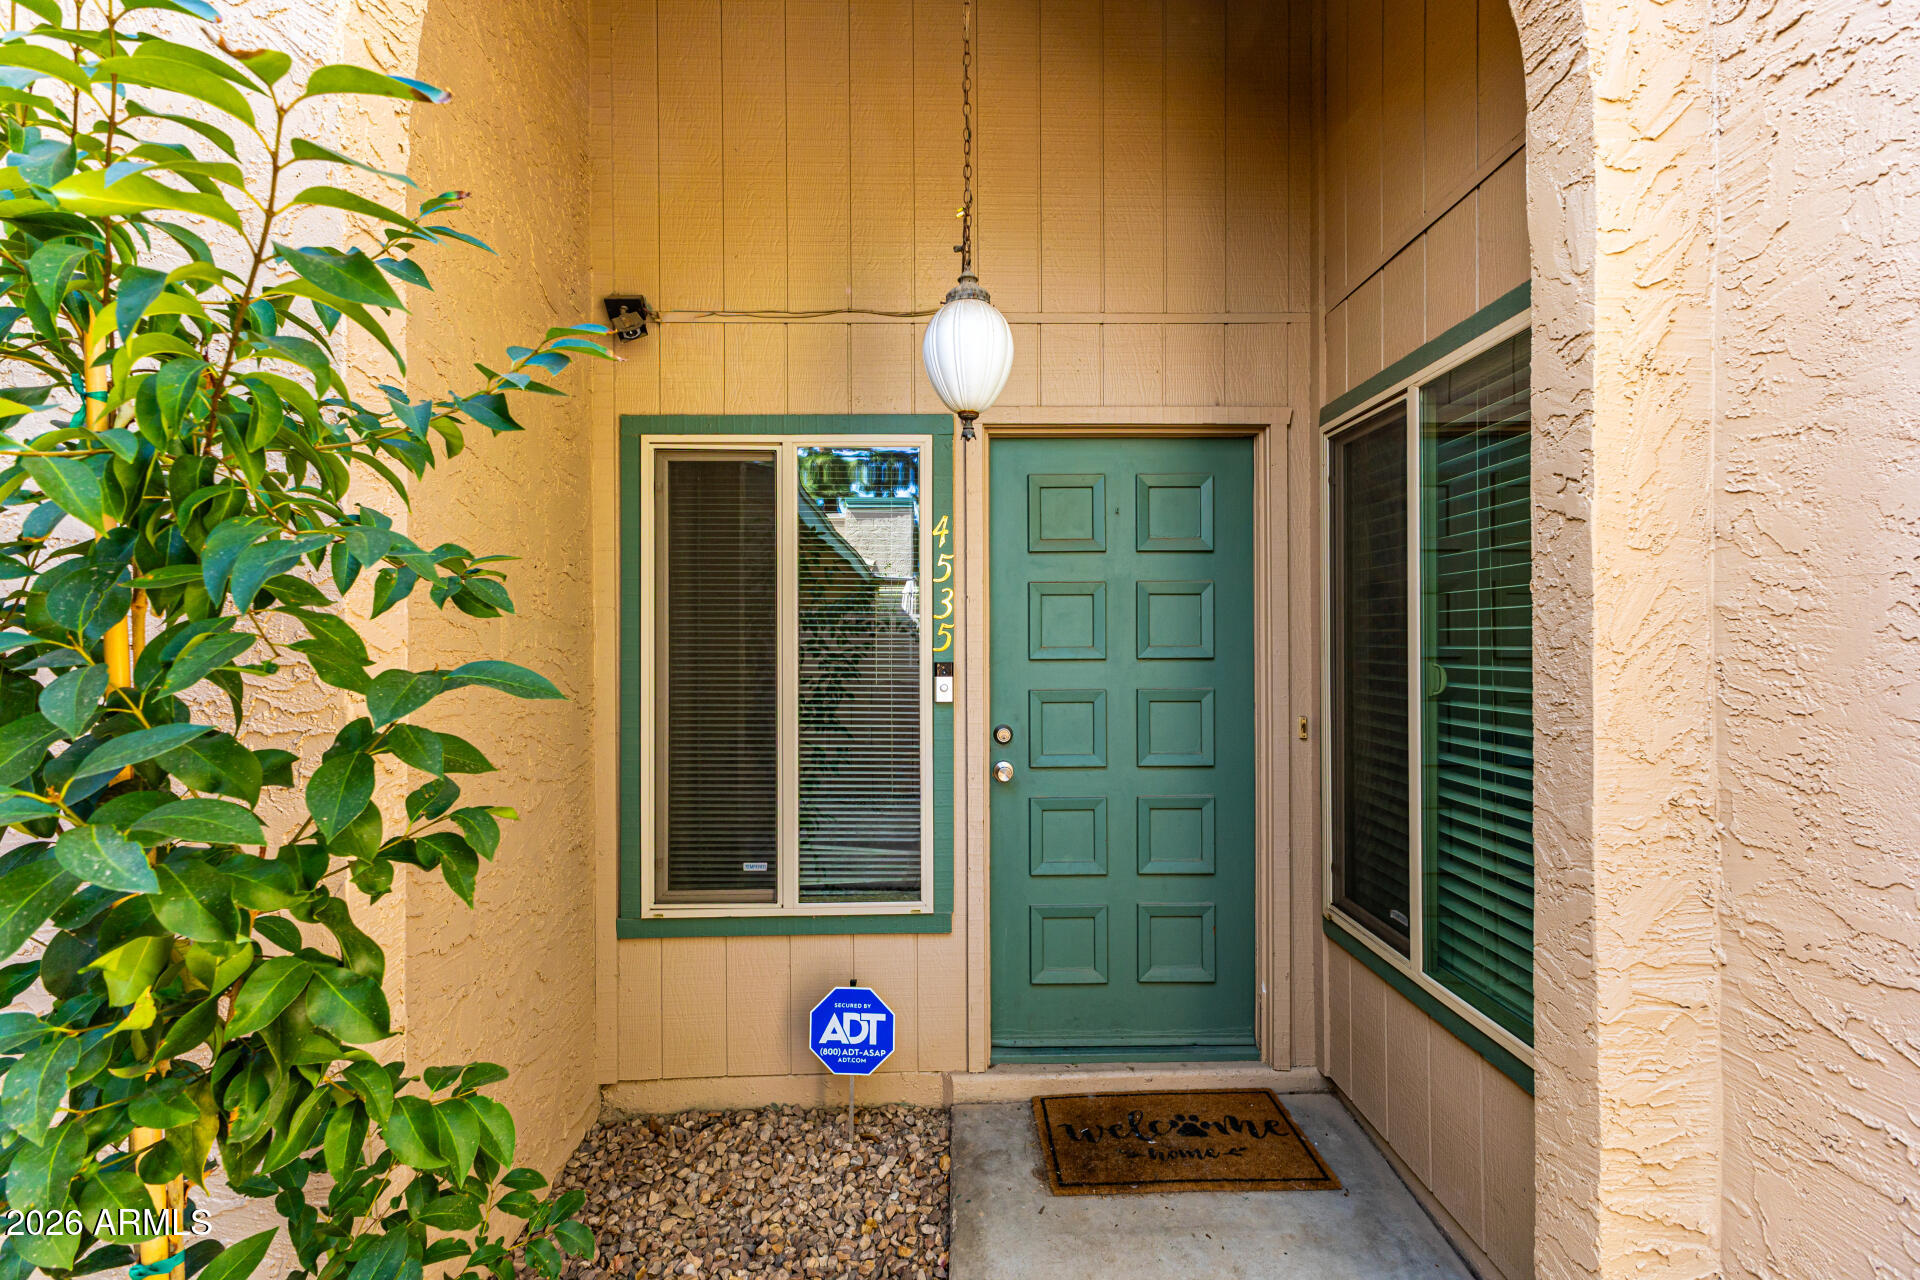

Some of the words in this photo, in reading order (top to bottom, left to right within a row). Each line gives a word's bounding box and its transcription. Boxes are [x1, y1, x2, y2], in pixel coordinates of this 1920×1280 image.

[932, 515, 954, 652] 4535
[818, 1011, 886, 1045] ADT
[820, 1047, 841, 1057] (800)
[842, 1048, 886, 1057] ADT-ASAP
[1150, 1147, 1220, 1161] home
